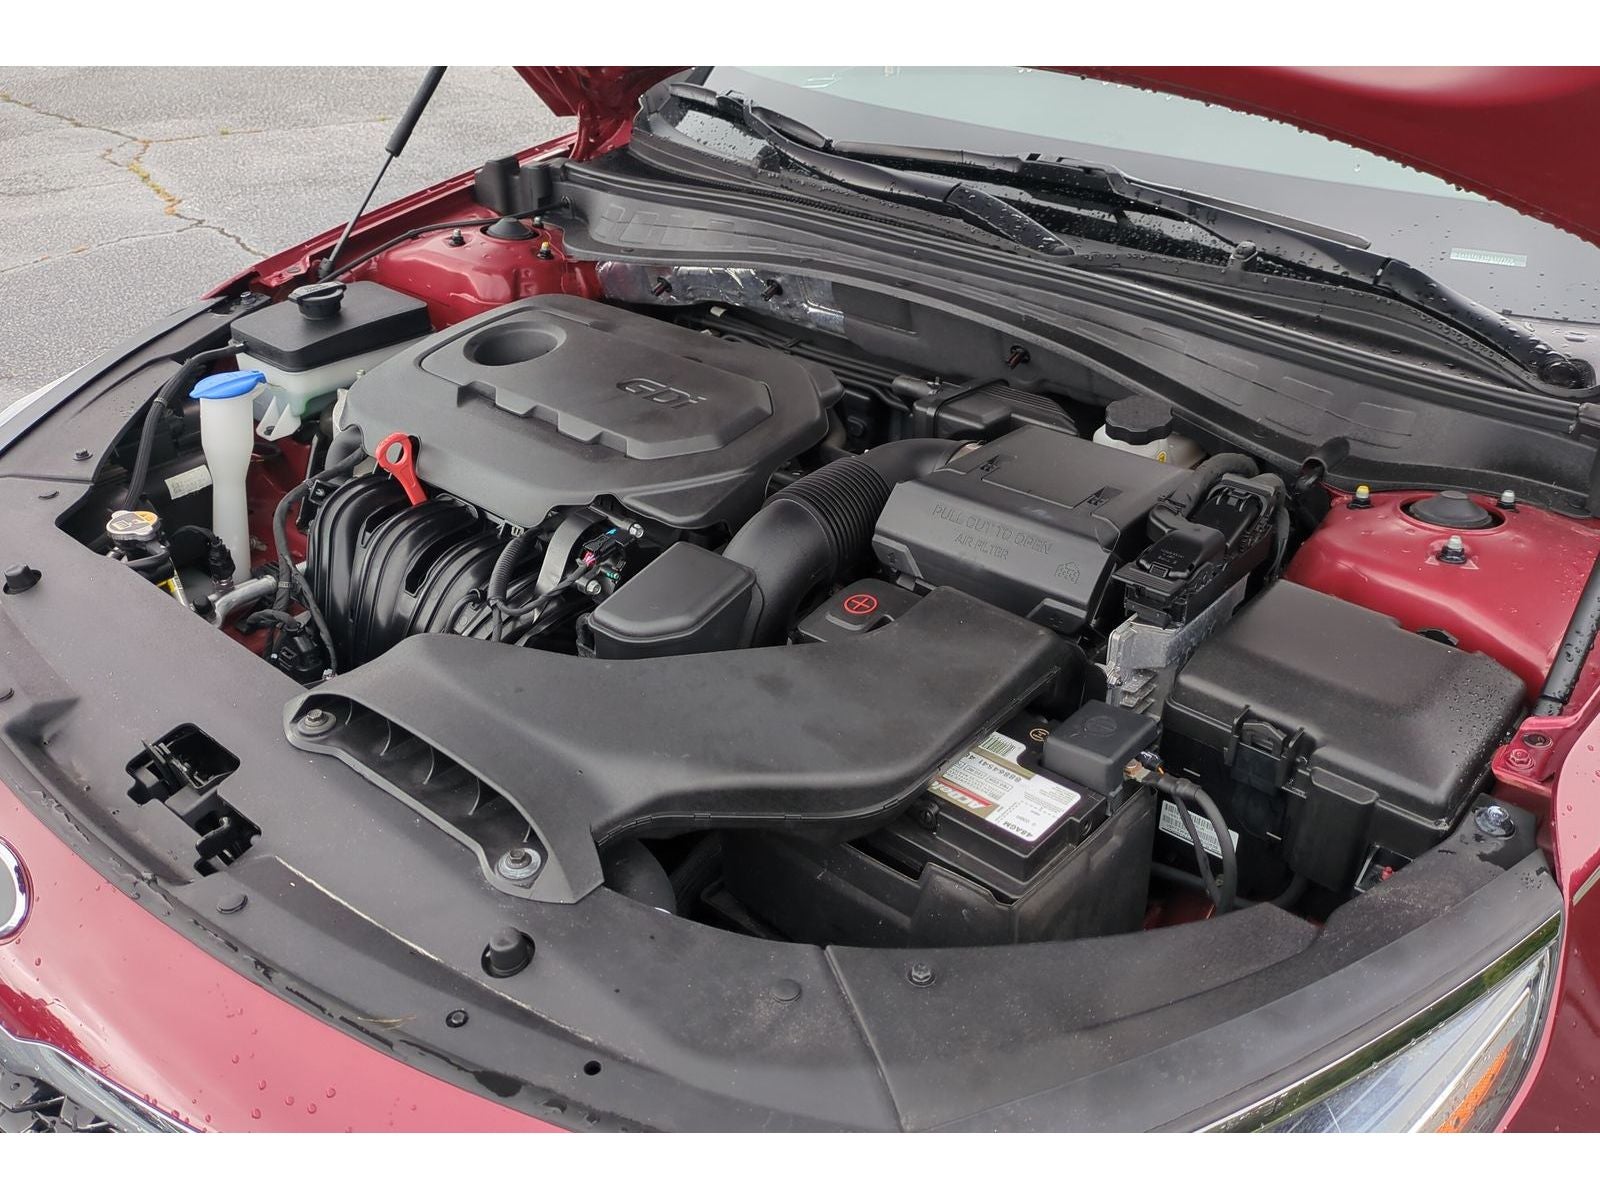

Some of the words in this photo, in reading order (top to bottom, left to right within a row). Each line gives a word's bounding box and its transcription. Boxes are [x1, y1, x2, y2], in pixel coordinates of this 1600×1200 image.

[932, 503, 963, 525] PULL
[966, 515, 991, 532] OUT
[994, 523, 1013, 540] TO
[1014, 532, 1053, 555] OPEN
[954, 534, 974, 548] AIR
[974, 538, 1010, 560] FILTER
